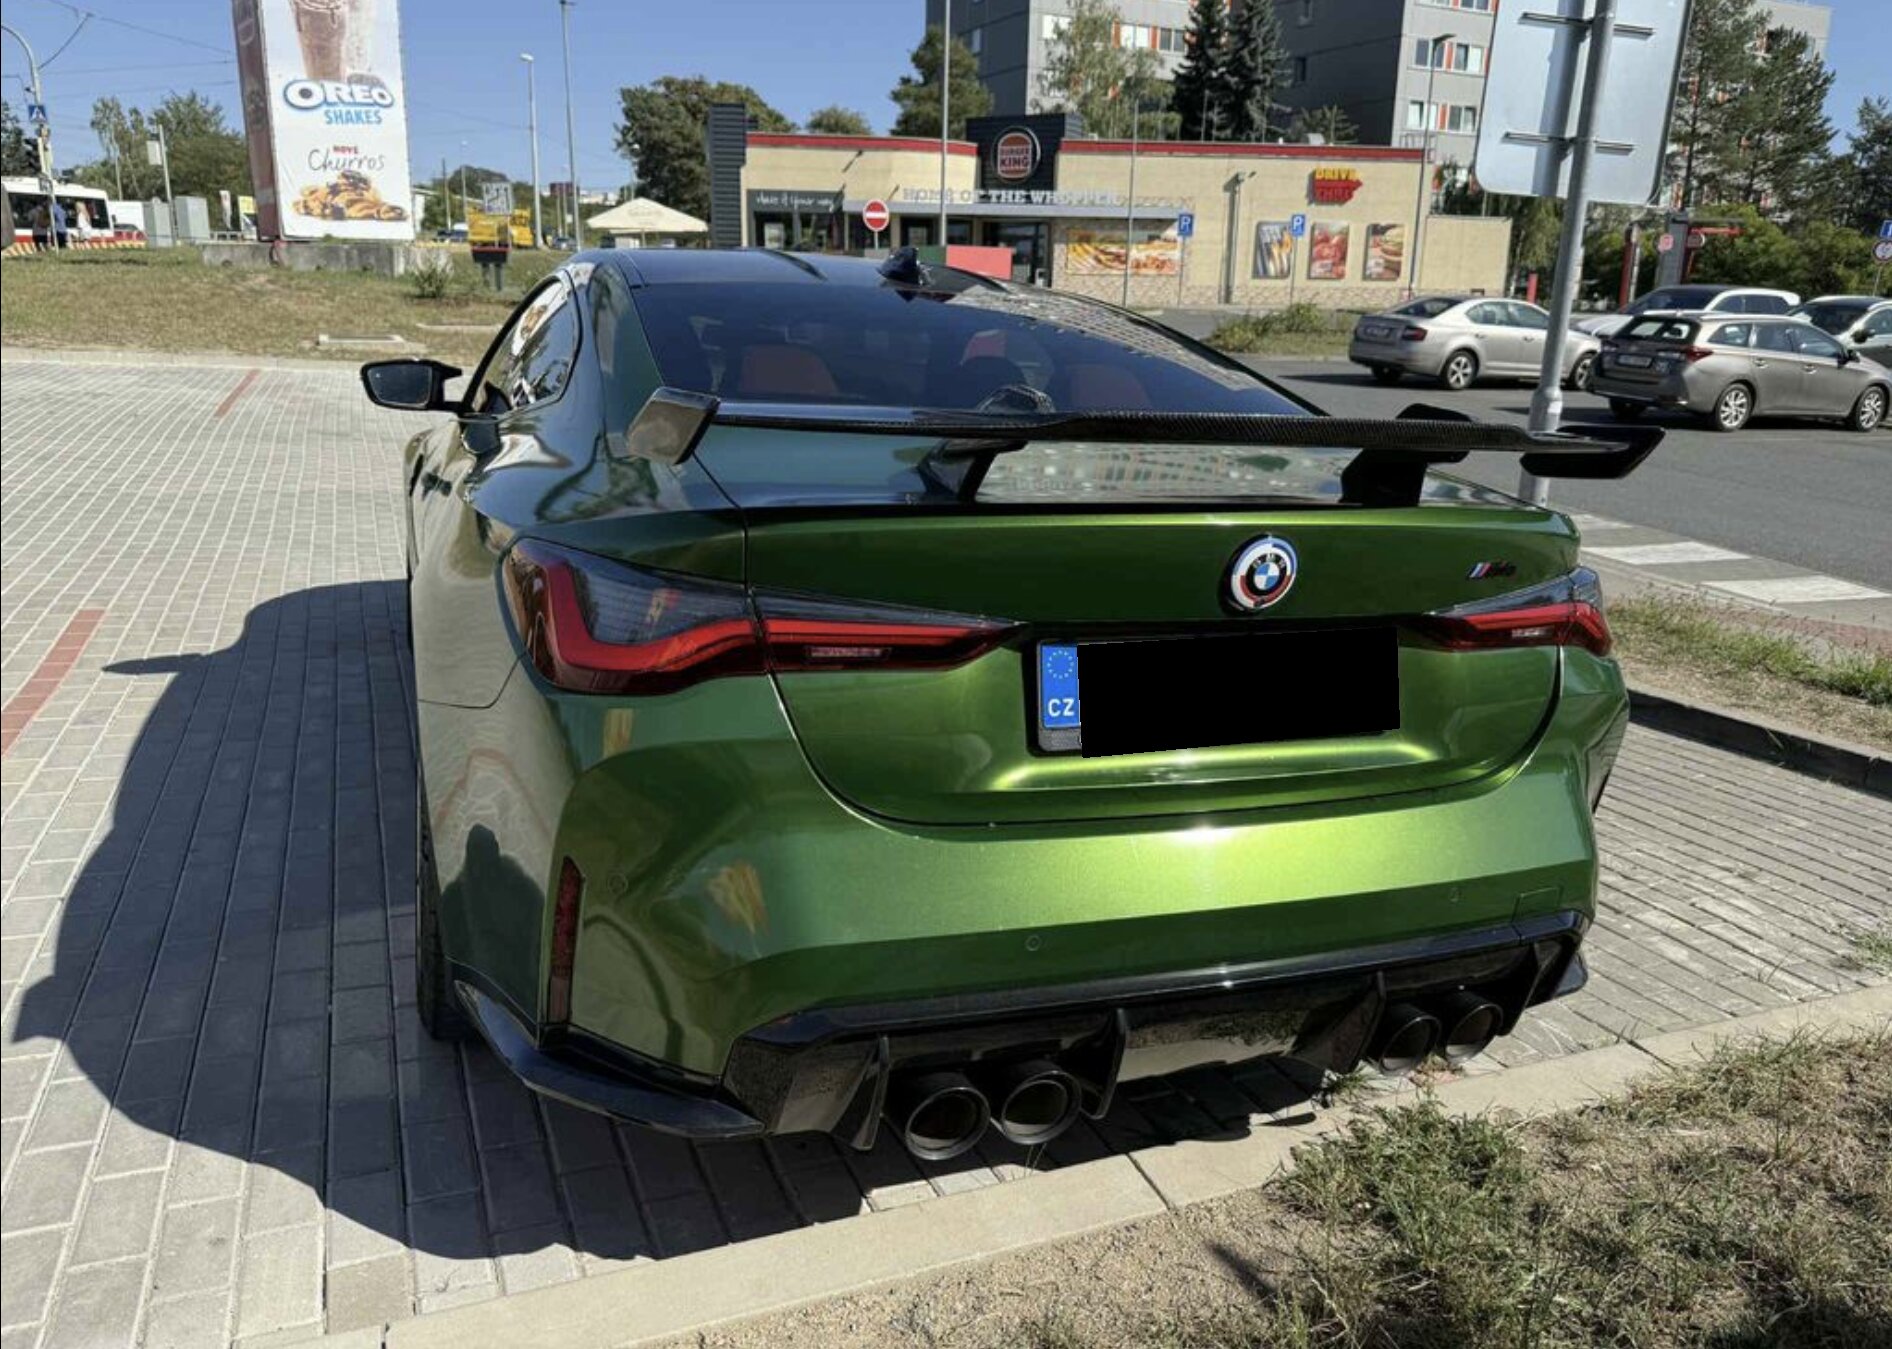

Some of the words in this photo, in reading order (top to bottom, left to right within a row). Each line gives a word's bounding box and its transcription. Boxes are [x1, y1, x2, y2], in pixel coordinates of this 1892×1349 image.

[284, 80, 394, 111] OREO
[324, 108, 383, 125] SHAKES
[308, 148, 386, 171] Churros
[1000, 156, 1030, 169] KING
[903, 187, 955, 203] HOME
[988, 189, 1026, 204] THE
[1293, 215, 1303, 230] P
[1048, 698, 1075, 717] CZ
